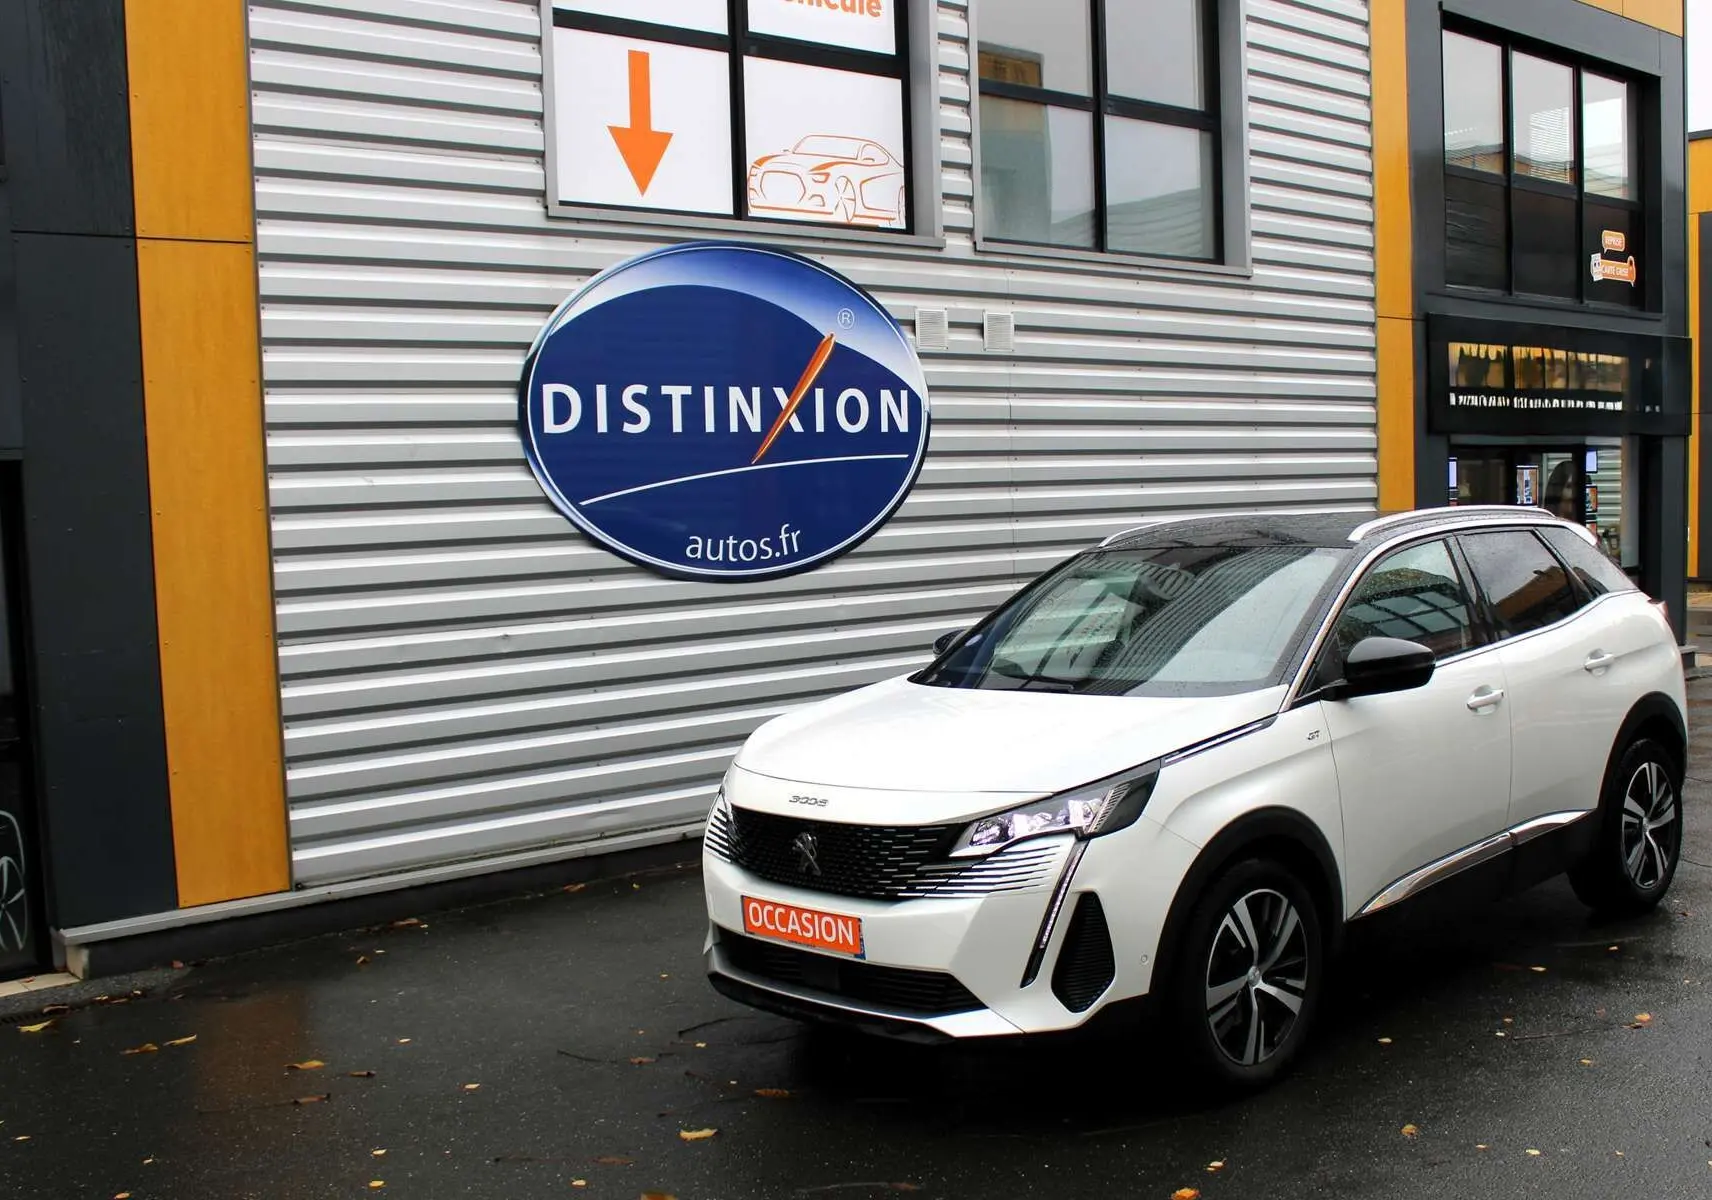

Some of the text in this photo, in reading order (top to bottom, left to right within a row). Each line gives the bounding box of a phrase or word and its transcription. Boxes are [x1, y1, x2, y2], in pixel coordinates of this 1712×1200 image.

[541, 383, 909, 434] DISTINXION
[685, 523, 801, 562] autos.fr
[748, 902, 855, 946] OCCASION
